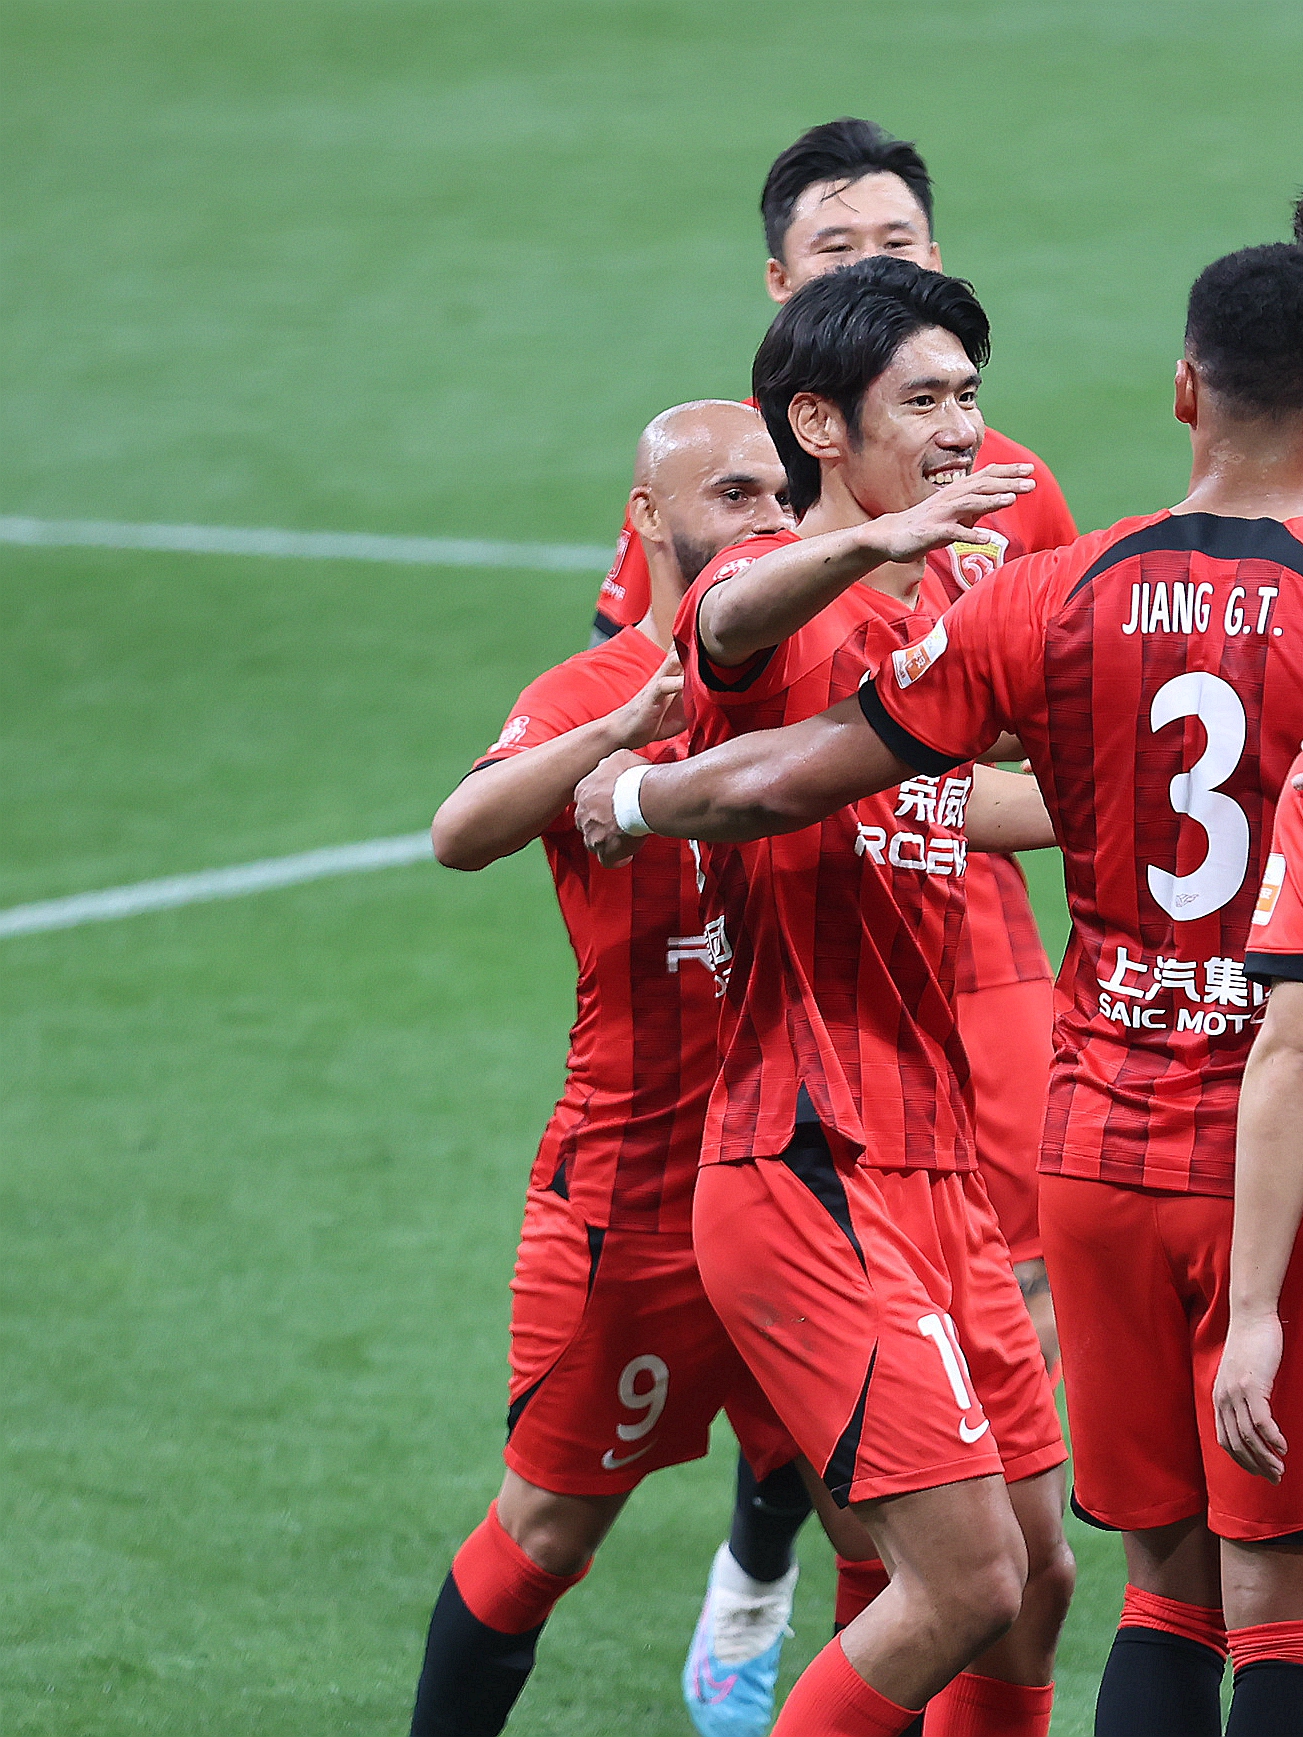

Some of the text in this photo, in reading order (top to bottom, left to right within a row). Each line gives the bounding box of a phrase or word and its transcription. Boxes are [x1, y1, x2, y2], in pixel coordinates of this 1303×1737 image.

[1122, 581, 1284, 637] JIANG G.T.
[1147, 671, 1251, 922] 3
[1099, 992, 1267, 1036] SAIC MOT
[616, 1353, 670, 1442] 9
